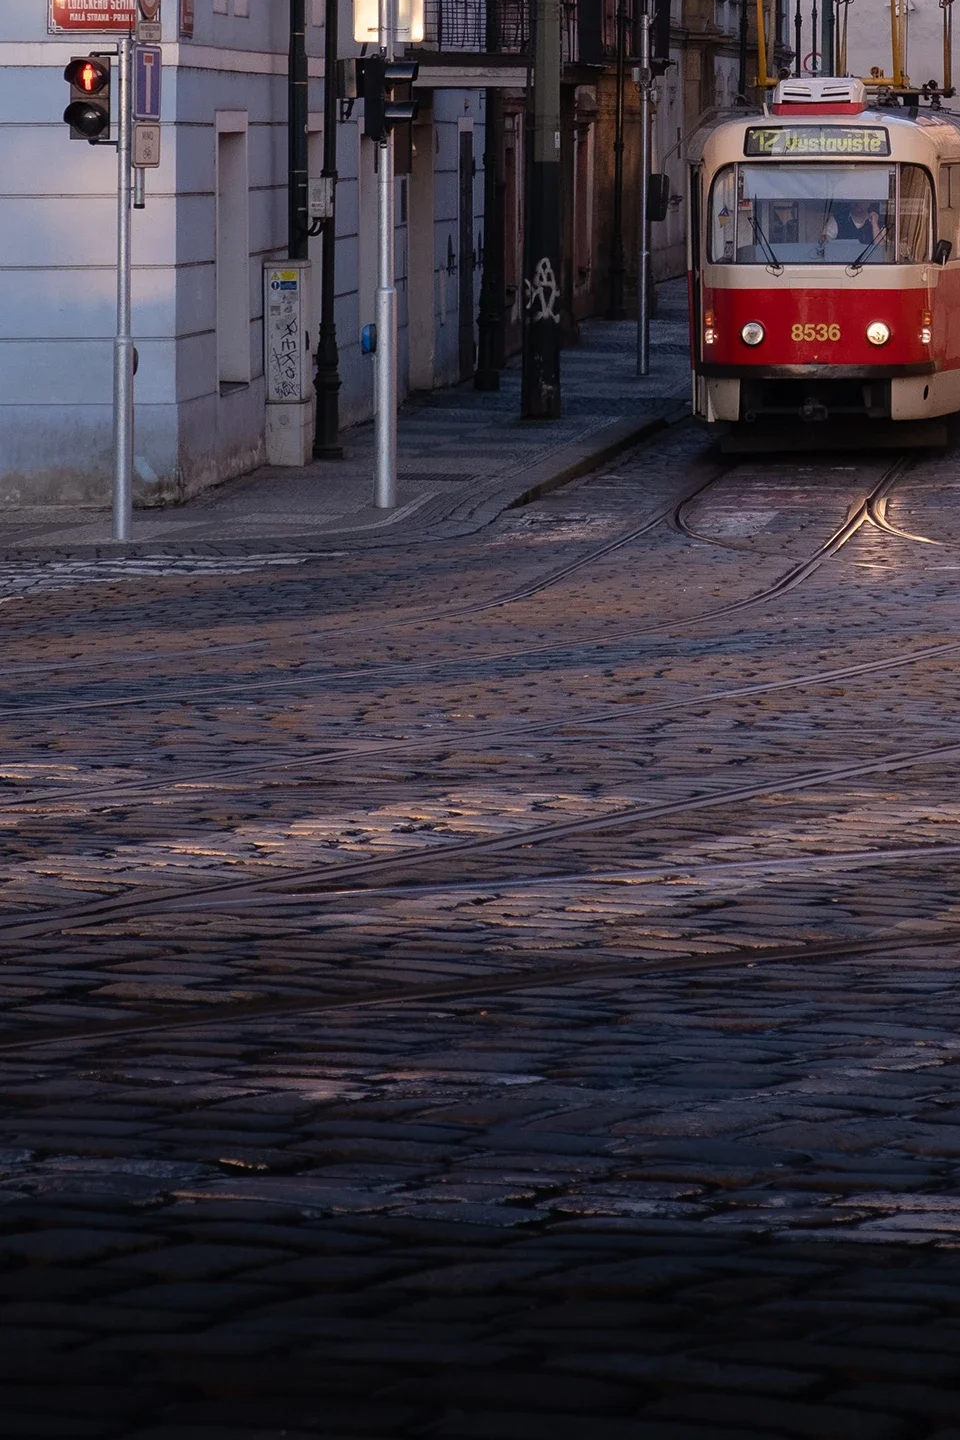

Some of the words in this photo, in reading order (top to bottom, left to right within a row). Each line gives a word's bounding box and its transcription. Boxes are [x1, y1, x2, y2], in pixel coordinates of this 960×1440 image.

[70, 12, 86, 21] MALÁ
[87, 13, 110, 21] STRANA
[753, 129, 783, 152] 12
[785, 129, 882, 152] Výstaviště
[791, 323, 841, 342] 8536
